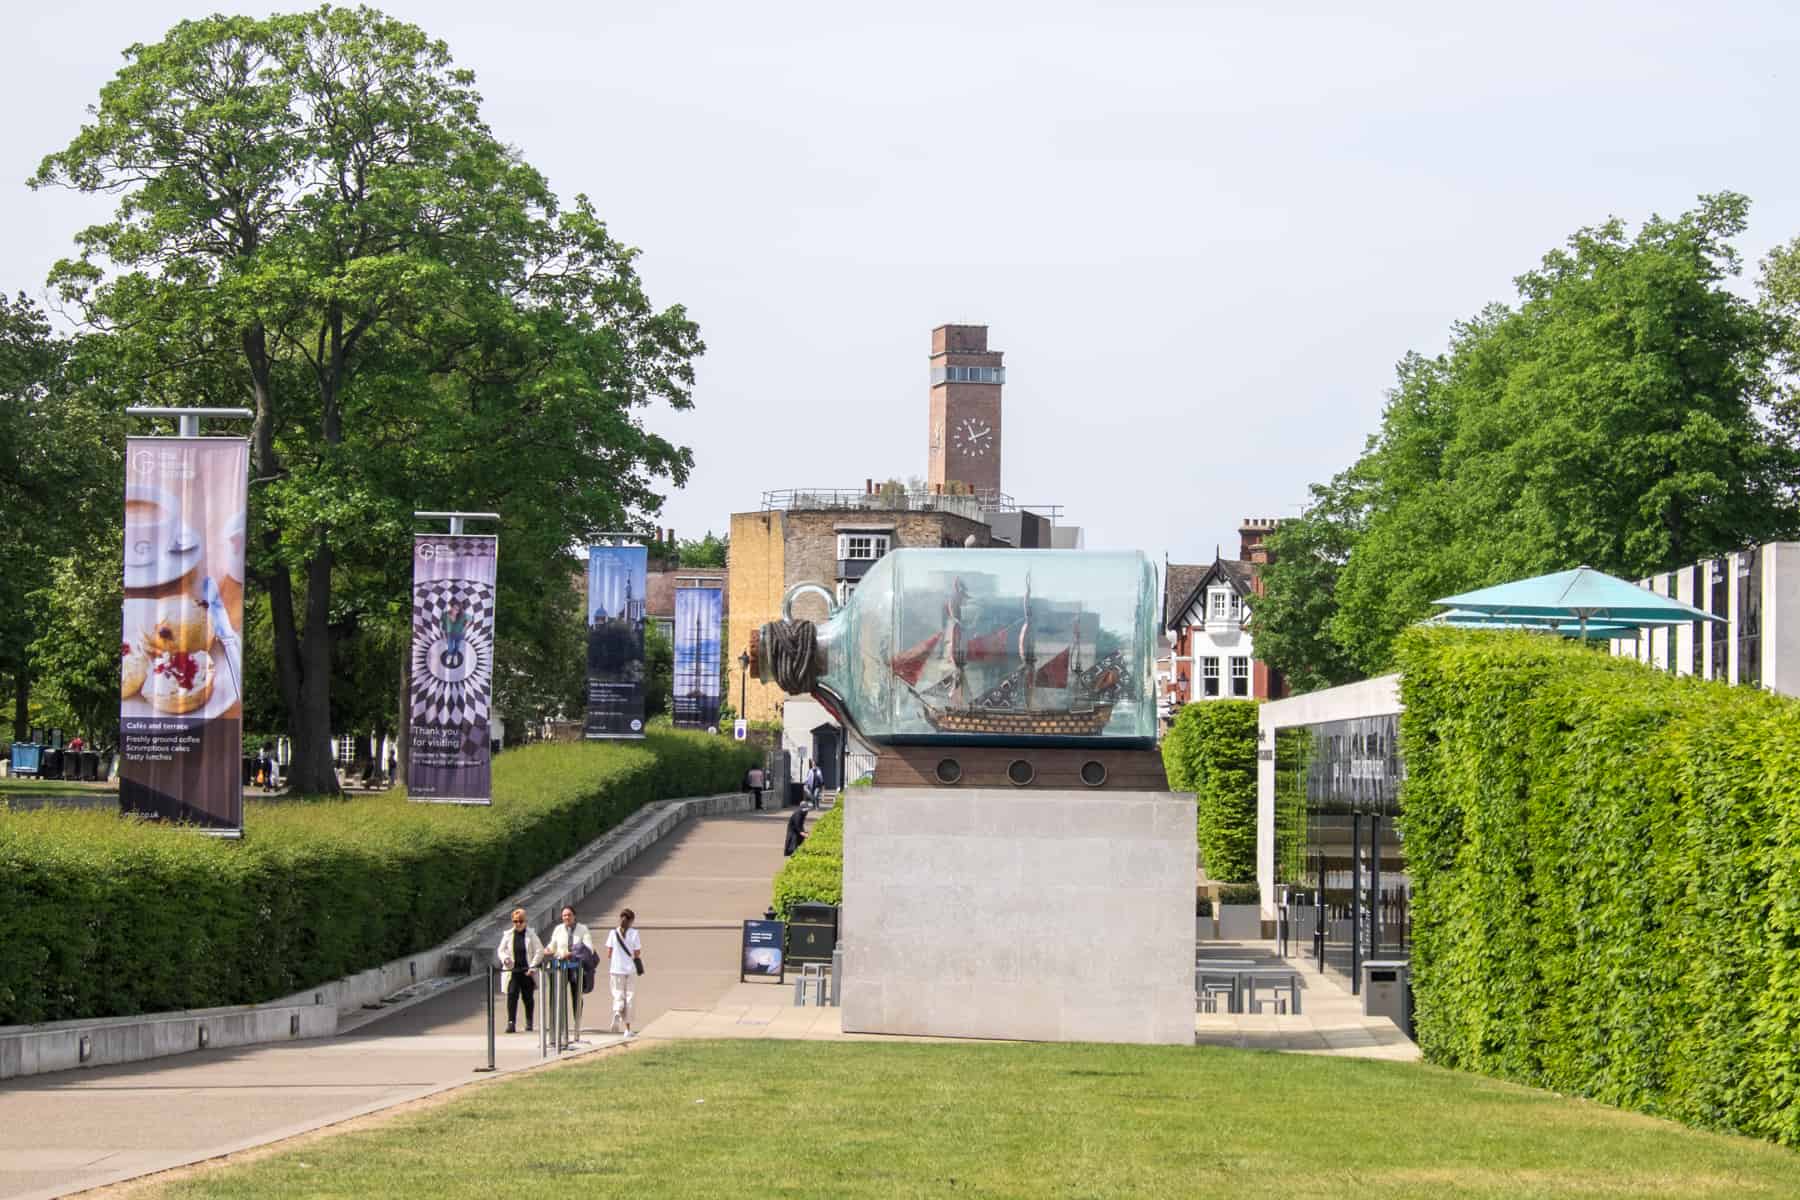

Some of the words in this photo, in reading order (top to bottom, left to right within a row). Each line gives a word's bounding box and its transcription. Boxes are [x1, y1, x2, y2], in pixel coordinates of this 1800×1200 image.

[149, 722, 162, 730] and
[163, 722, 189, 730] terrace
[413, 727, 440, 735] Thank
[441, 729, 458, 737] you
[126, 736, 150, 744] Freshly
[152, 736, 178, 744] ground
[179, 736, 200, 744] coffee
[428, 738, 459, 748] visiting
[126, 754, 144, 762] Tasty
